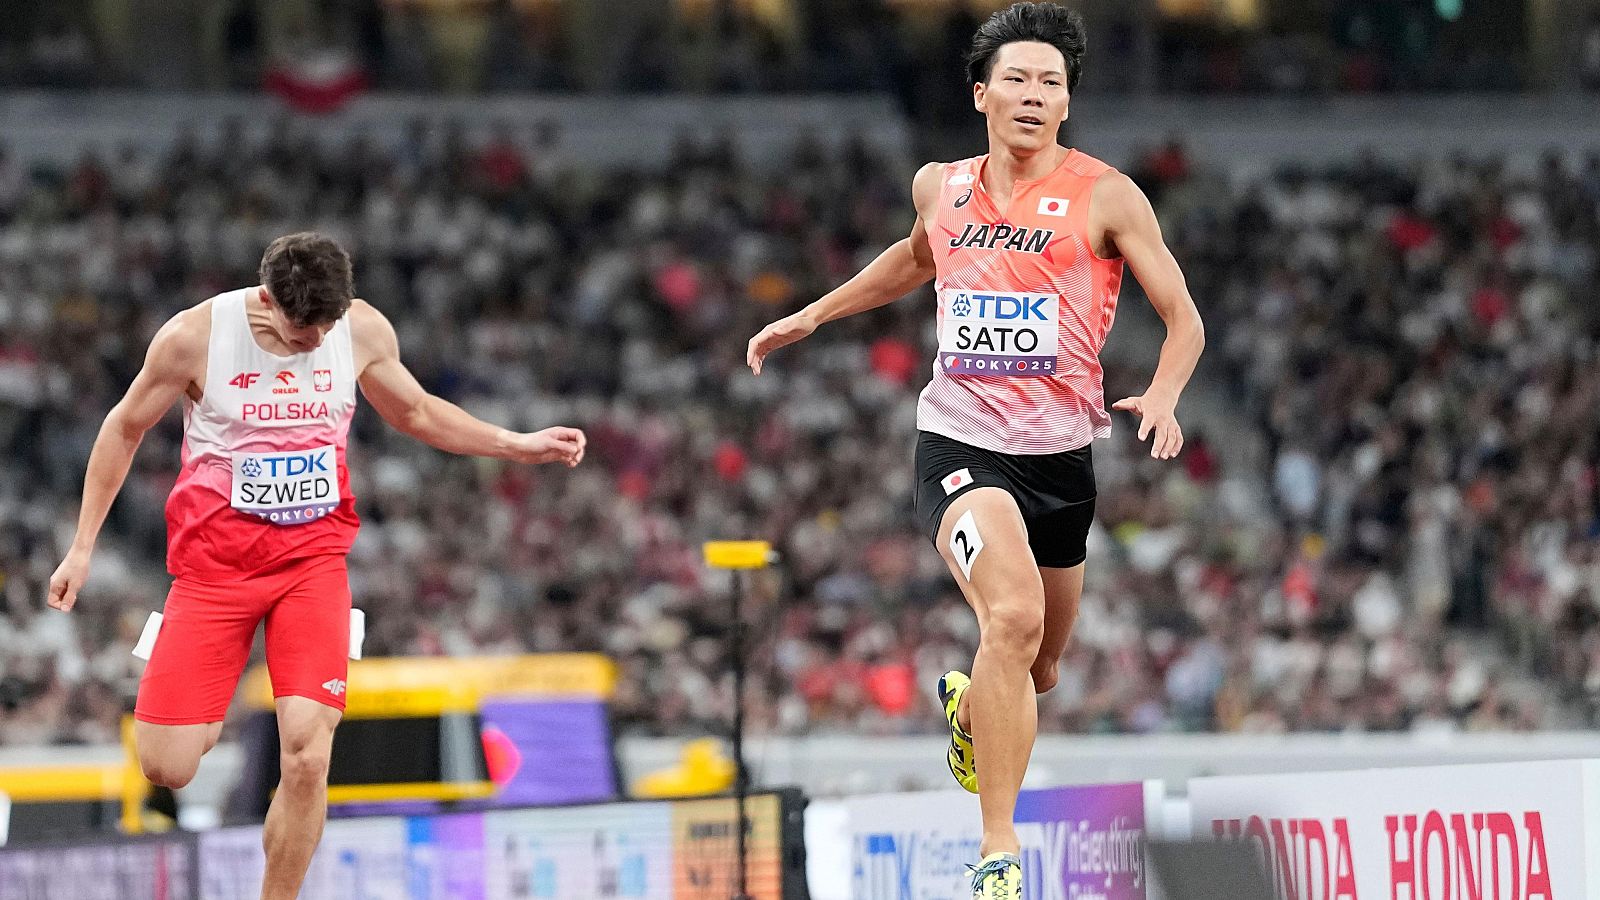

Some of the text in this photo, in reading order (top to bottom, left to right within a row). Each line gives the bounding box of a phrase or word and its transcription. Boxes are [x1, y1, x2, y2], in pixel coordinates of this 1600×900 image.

[950, 223, 1054, 254] JAPAN
[973, 294, 1049, 321] TDK
[955, 325, 1039, 353] SATO
[228, 372, 261, 389] 4F
[242, 402, 328, 421] POLSKA
[262, 451, 328, 477] TDK
[240, 478, 330, 504] SZWED
[954, 529, 975, 565] 2
[321, 678, 346, 697] 4F
[1384, 809, 1553, 900] HONDA
